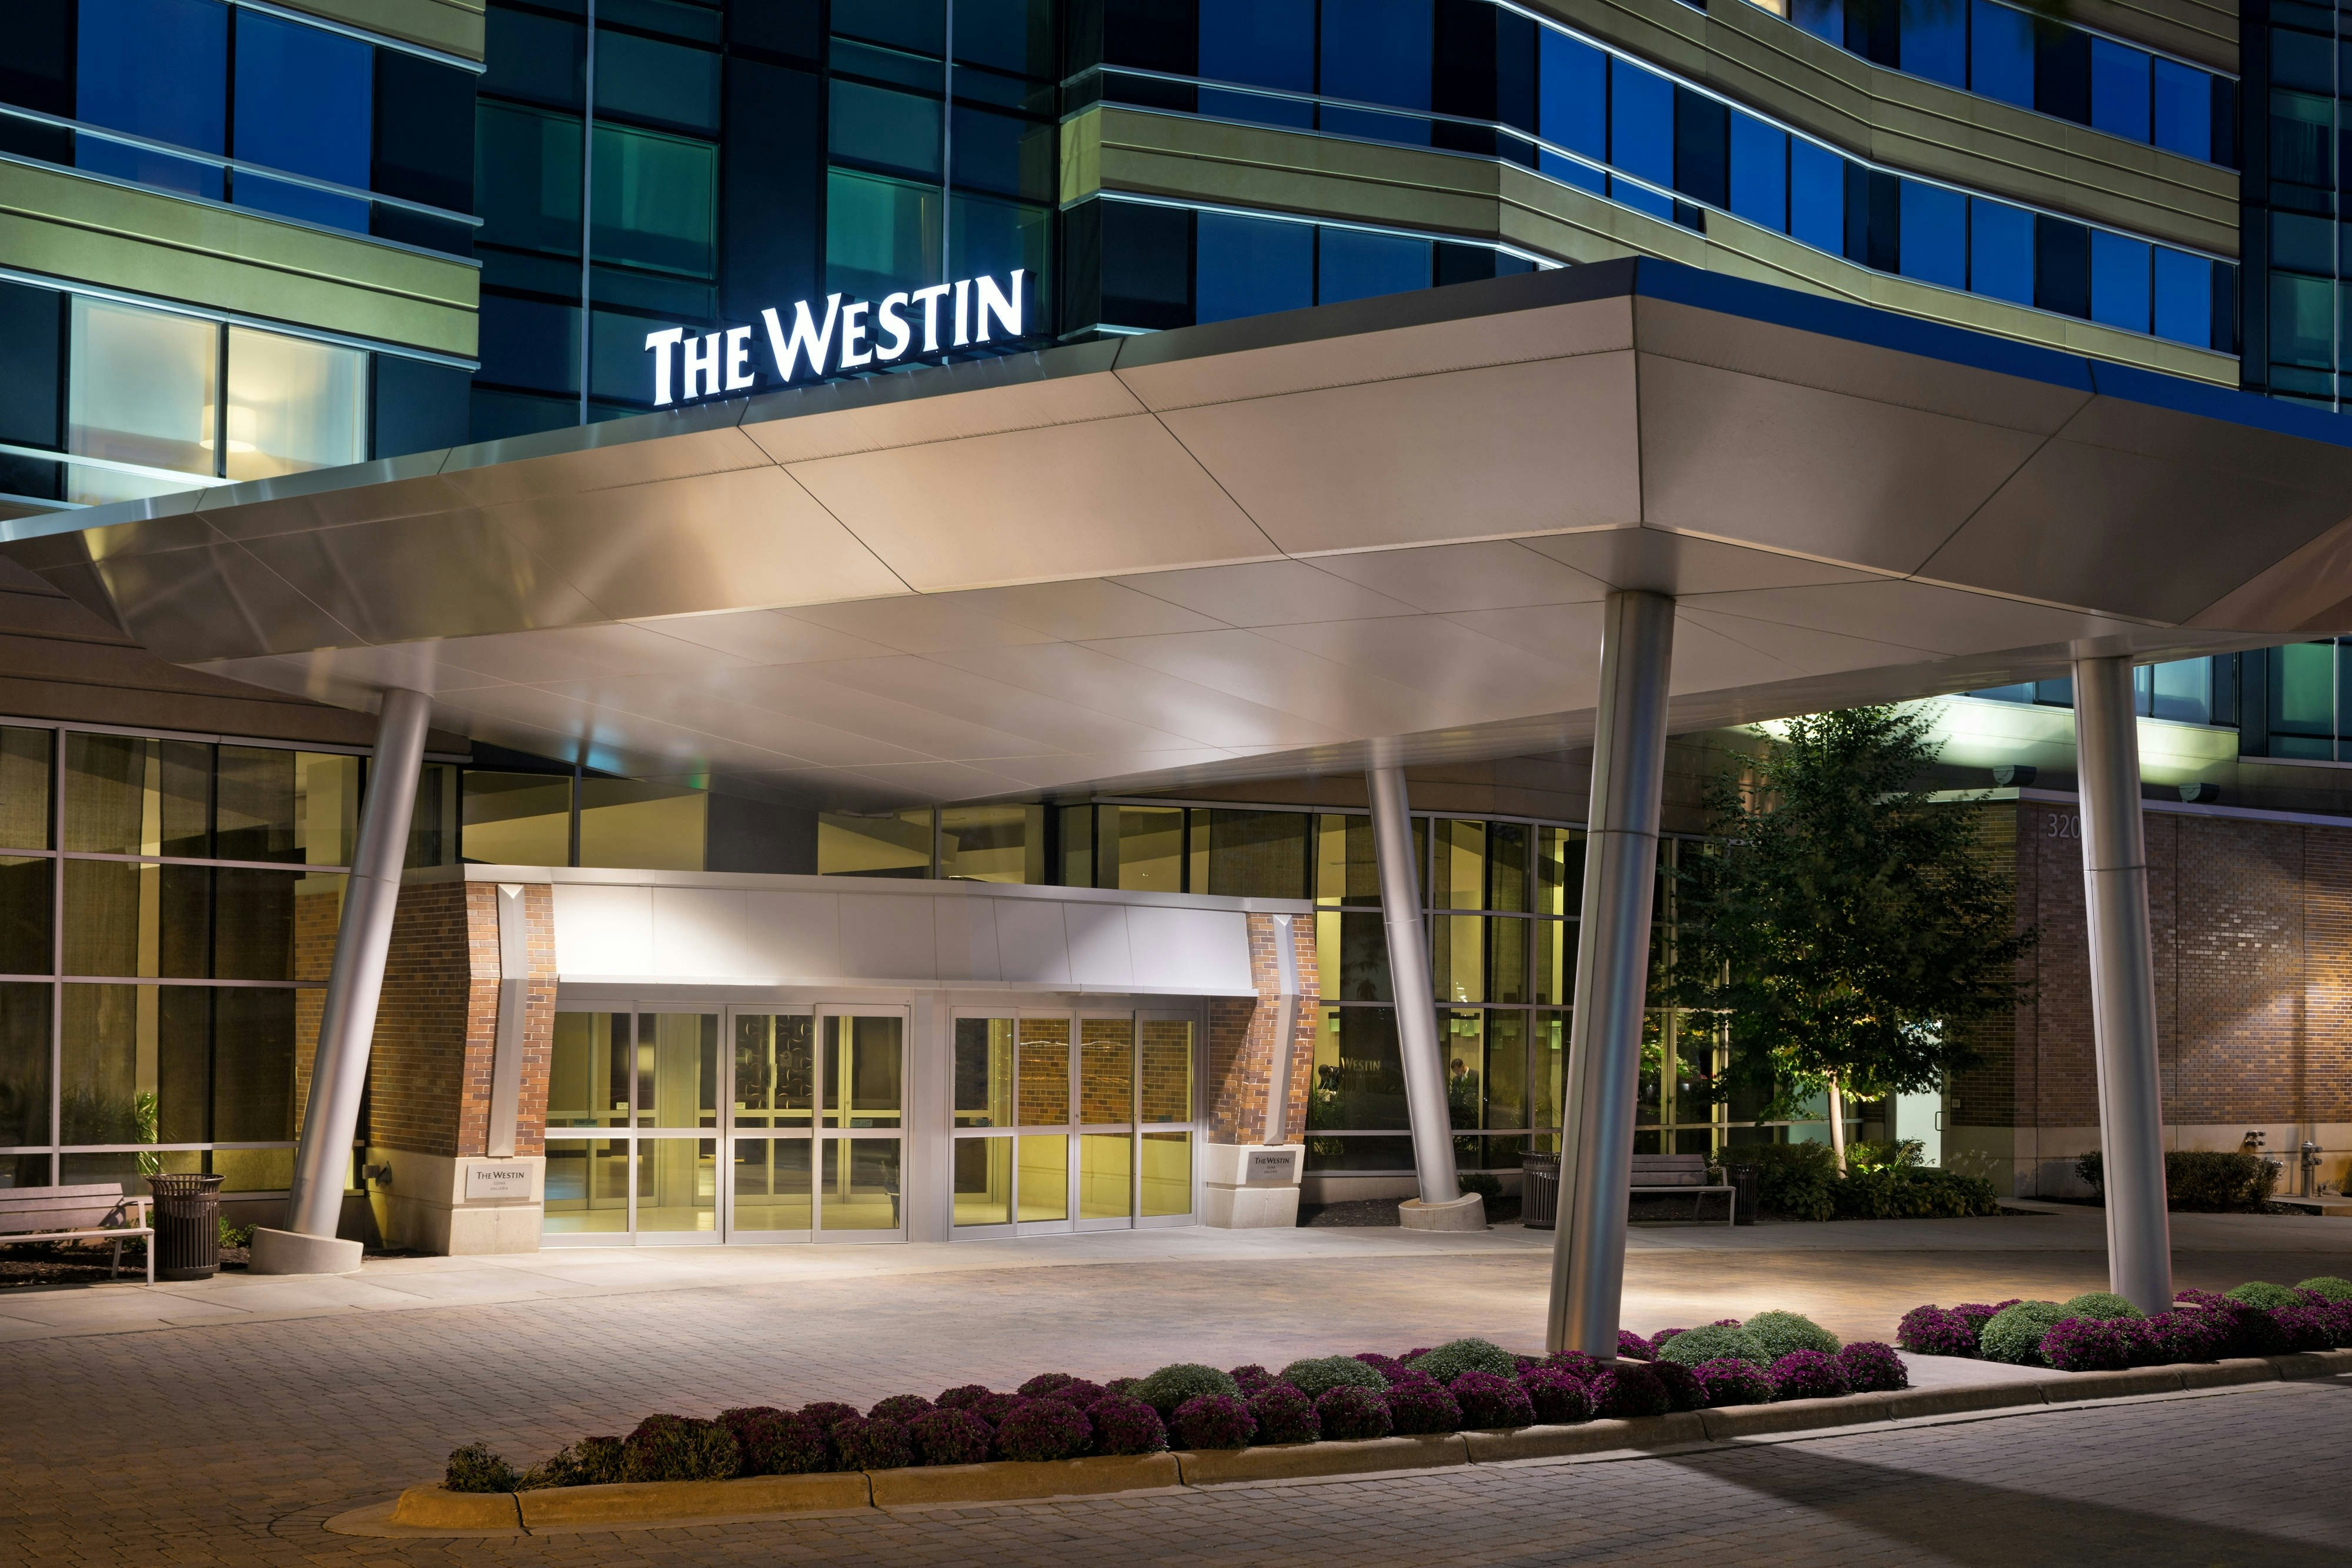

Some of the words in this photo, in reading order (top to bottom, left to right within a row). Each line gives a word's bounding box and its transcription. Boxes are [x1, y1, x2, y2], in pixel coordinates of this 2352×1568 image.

[645, 325, 756, 406] THE
[761, 269, 1025, 382] WESTIN
[2047, 813, 2081, 839] 320
[1341, 1057, 1381, 1071] WESTIN
